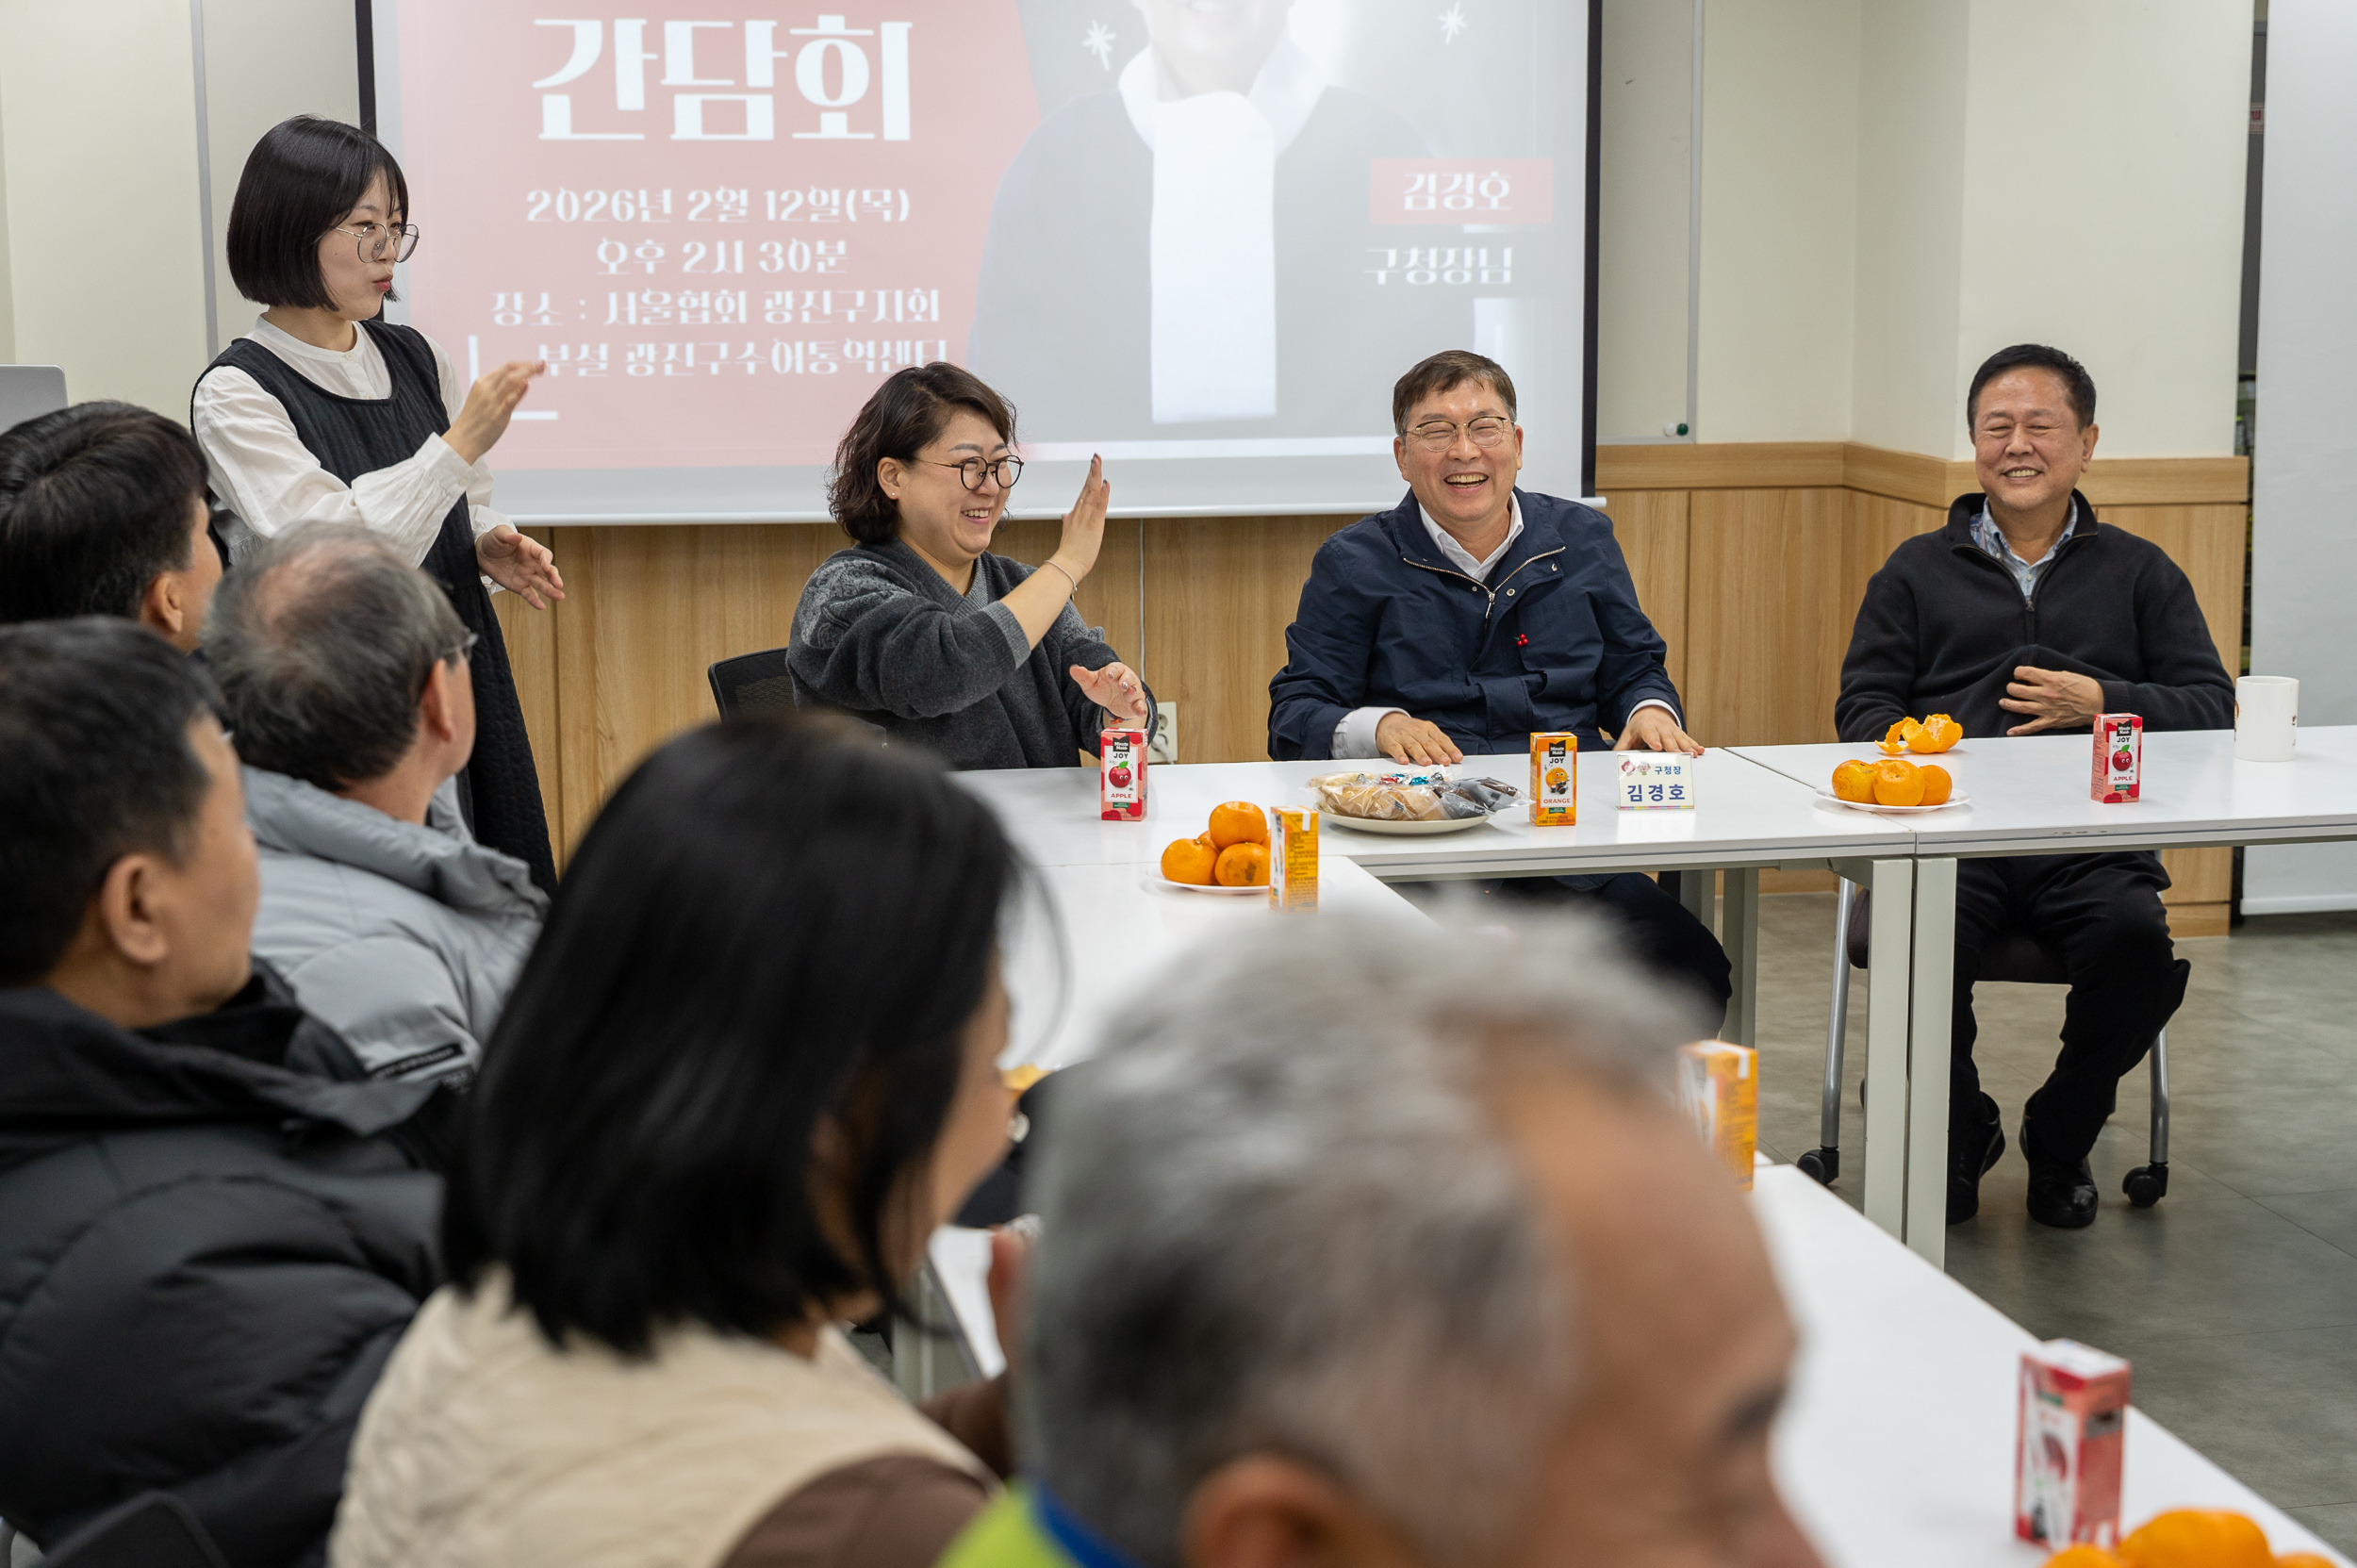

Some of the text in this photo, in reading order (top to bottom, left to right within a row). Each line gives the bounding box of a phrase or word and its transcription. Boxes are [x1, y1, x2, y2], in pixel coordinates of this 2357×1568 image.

[532, 14, 914, 140] 간담회
[526, 186, 911, 223] 2026년 2월 12일(목)
[1403, 171, 1512, 211] 김경호
[596, 238, 849, 274] 오후 2시 30분
[1364, 247, 1512, 286] 구청장님
[490, 292, 564, 326] 장소
[603, 288, 748, 325] 서울협회
[763, 288, 940, 324] 광진구지회
[538, 342, 609, 377] 부설
[1655, 766, 1682, 775] 구청장
[1627, 784, 1686, 802] 김경호
